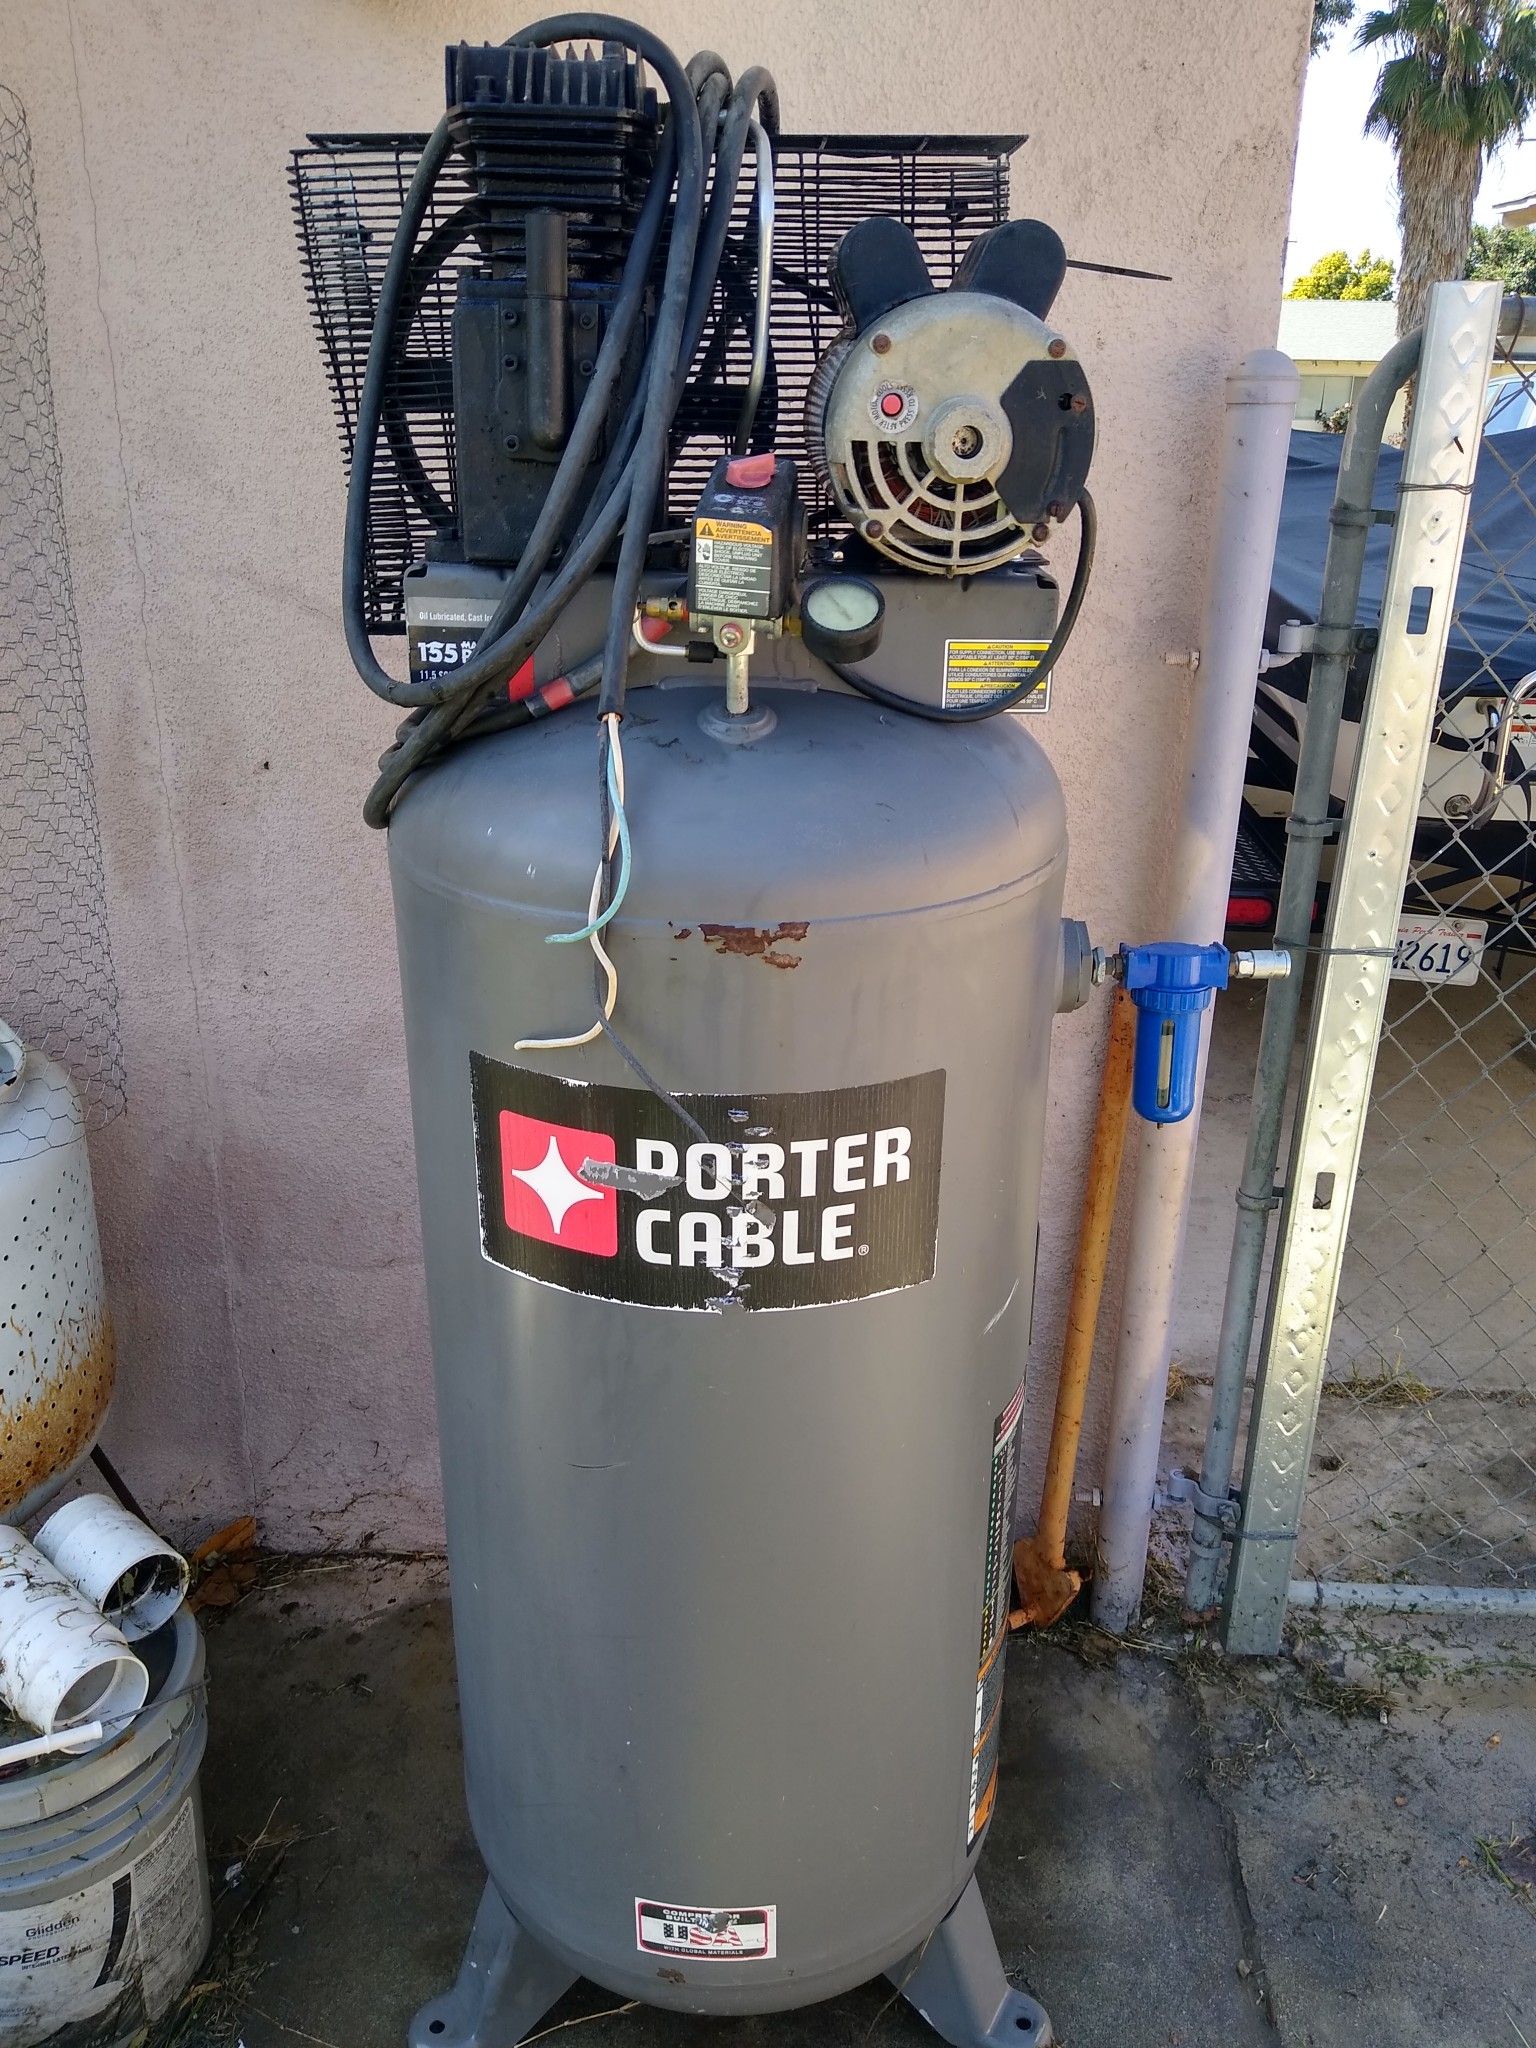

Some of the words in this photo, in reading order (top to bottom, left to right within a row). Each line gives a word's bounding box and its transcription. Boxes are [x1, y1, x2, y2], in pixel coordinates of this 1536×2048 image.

[715, 527, 761, 537] ADVERTENCIA
[716, 521, 747, 529] WARNING
[716, 533, 769, 543] AVERTISSEMENT
[420, 612, 428, 620] Oil
[430, 612, 466, 621] Lubricated,
[468, 614, 482, 622] Cast
[418, 641, 458, 664] 155
[420, 670, 436, 680] 11.5
[636, 1126, 912, 1200] PORTER
[636, 1203, 856, 1268] CABLE
[26, 1916, 80, 1938] Glidden
[663, 1923, 744, 1946] USA
[0, 1946, 60, 1967] SPEED
